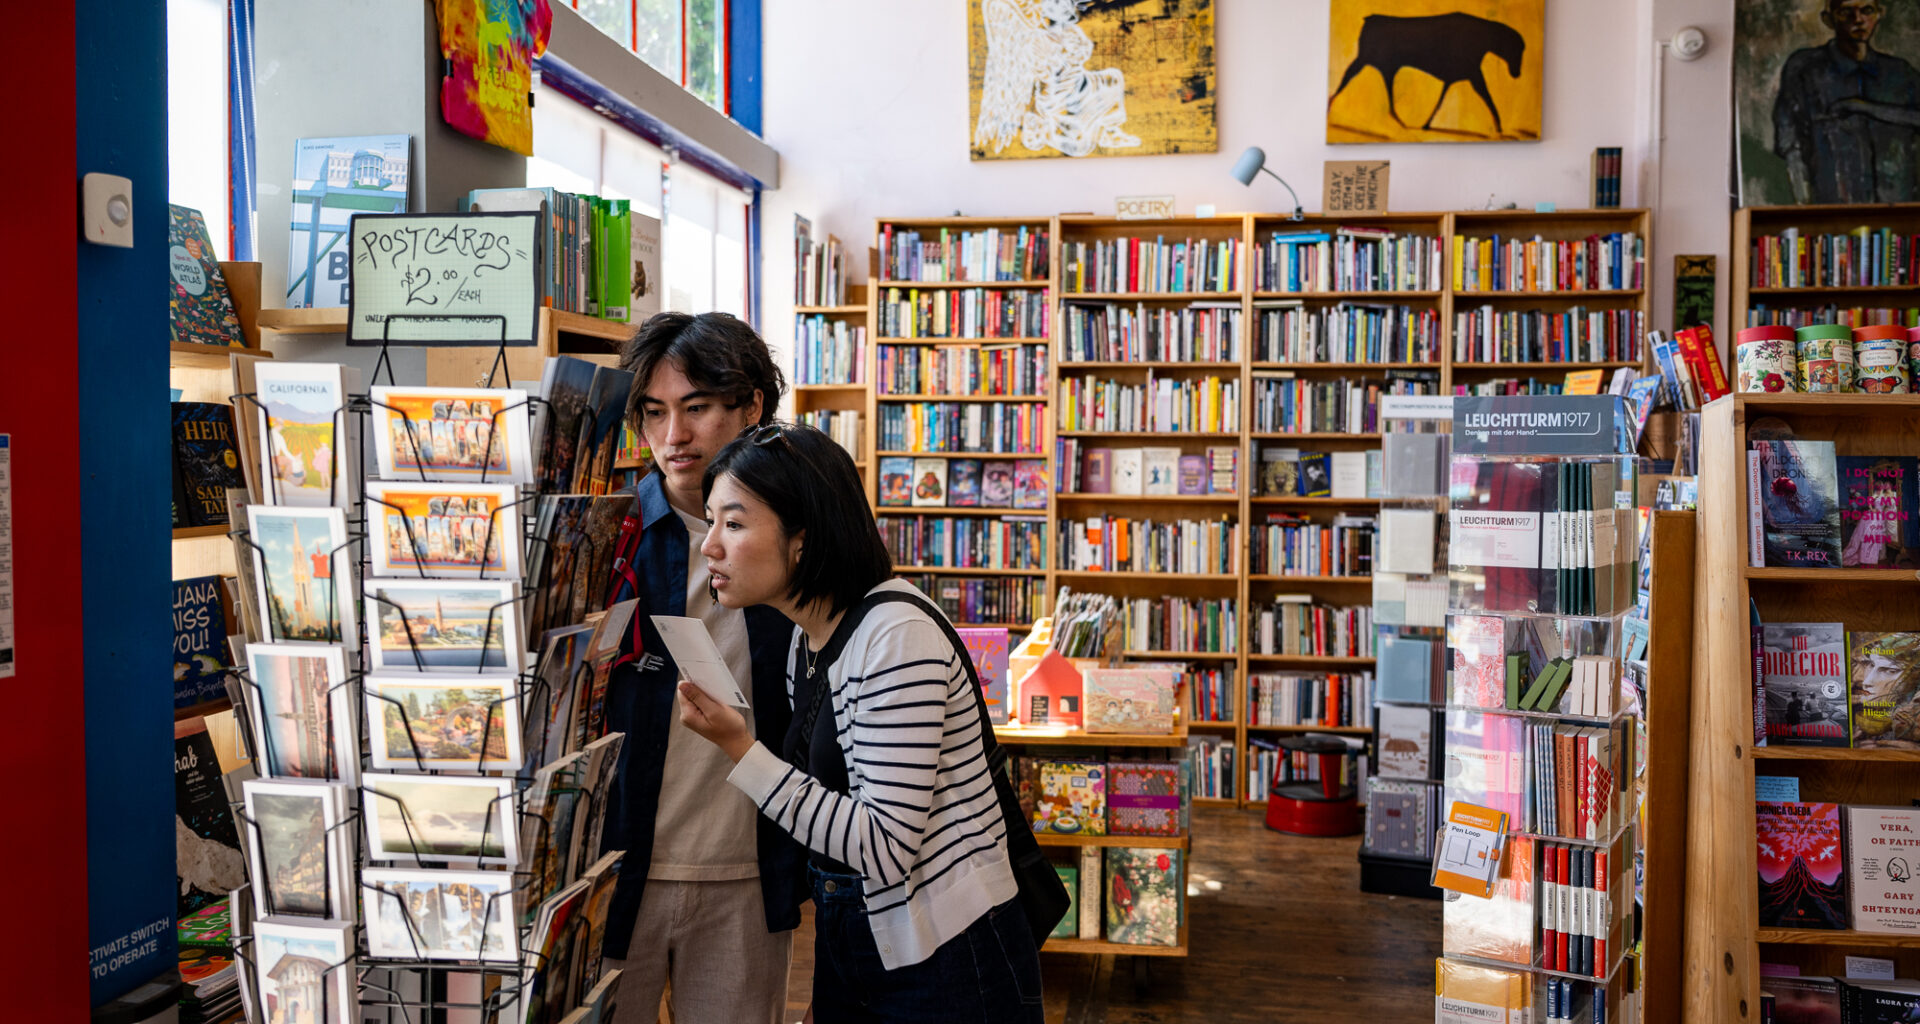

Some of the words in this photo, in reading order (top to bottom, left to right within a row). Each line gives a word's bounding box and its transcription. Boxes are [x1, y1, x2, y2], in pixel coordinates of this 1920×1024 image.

[1354, 165, 1367, 211] CREATIVE
[1117, 200, 1174, 217] POETRY
[361, 224, 511, 278] POSTCARDS
[173, 263, 201, 275] WORLD
[179, 274, 202, 285] ATLAS
[269, 384, 328, 394] CALIFORNIA
[1465, 412, 1592, 428] LEUCHTTURM1917
[183, 421, 234, 447] HEIR
[1757, 442, 1778, 453] THE
[1877, 468, 1905, 478] NOT
[196, 486, 227, 500] SAB
[1848, 496, 1875, 507] FOR
[1880, 496, 1902, 507] MY
[202, 501, 229, 515] TAH
[1460, 516, 1531, 527] LEUCHTTURM1917
[1843, 510, 1909, 521] POSITION
[1864, 534, 1892, 544] MEN
[1807, 551, 1829, 561] REX
[967, 636, 1004, 657] LLET
[1791, 635, 1808, 651] THE
[1764, 652, 1841, 677] DIRECTOR
[1756, 657, 1764, 686] Haunting
[1796, 723, 1843, 738] KEHLMANN
[1787, 806, 1812, 816] OJEDA
[1452, 825, 1464, 833] Pen
[1465, 829, 1481, 838] Loop
[1880, 823, 1913, 834] VERA,
[1871, 838, 1887, 846] OR
[1889, 838, 1920, 848] FAITH
[1884, 892, 1915, 901] GARY
[1862, 905, 1920, 915] SHTEYNGA
[130, 917, 170, 941] SWITCH
[92, 964, 107, 980] TO
[109, 939, 158, 972] OPERATE
[1876, 998, 1902, 1007] LAURA
[1441, 1001, 1499, 1019] LEUCHTTURM1917
